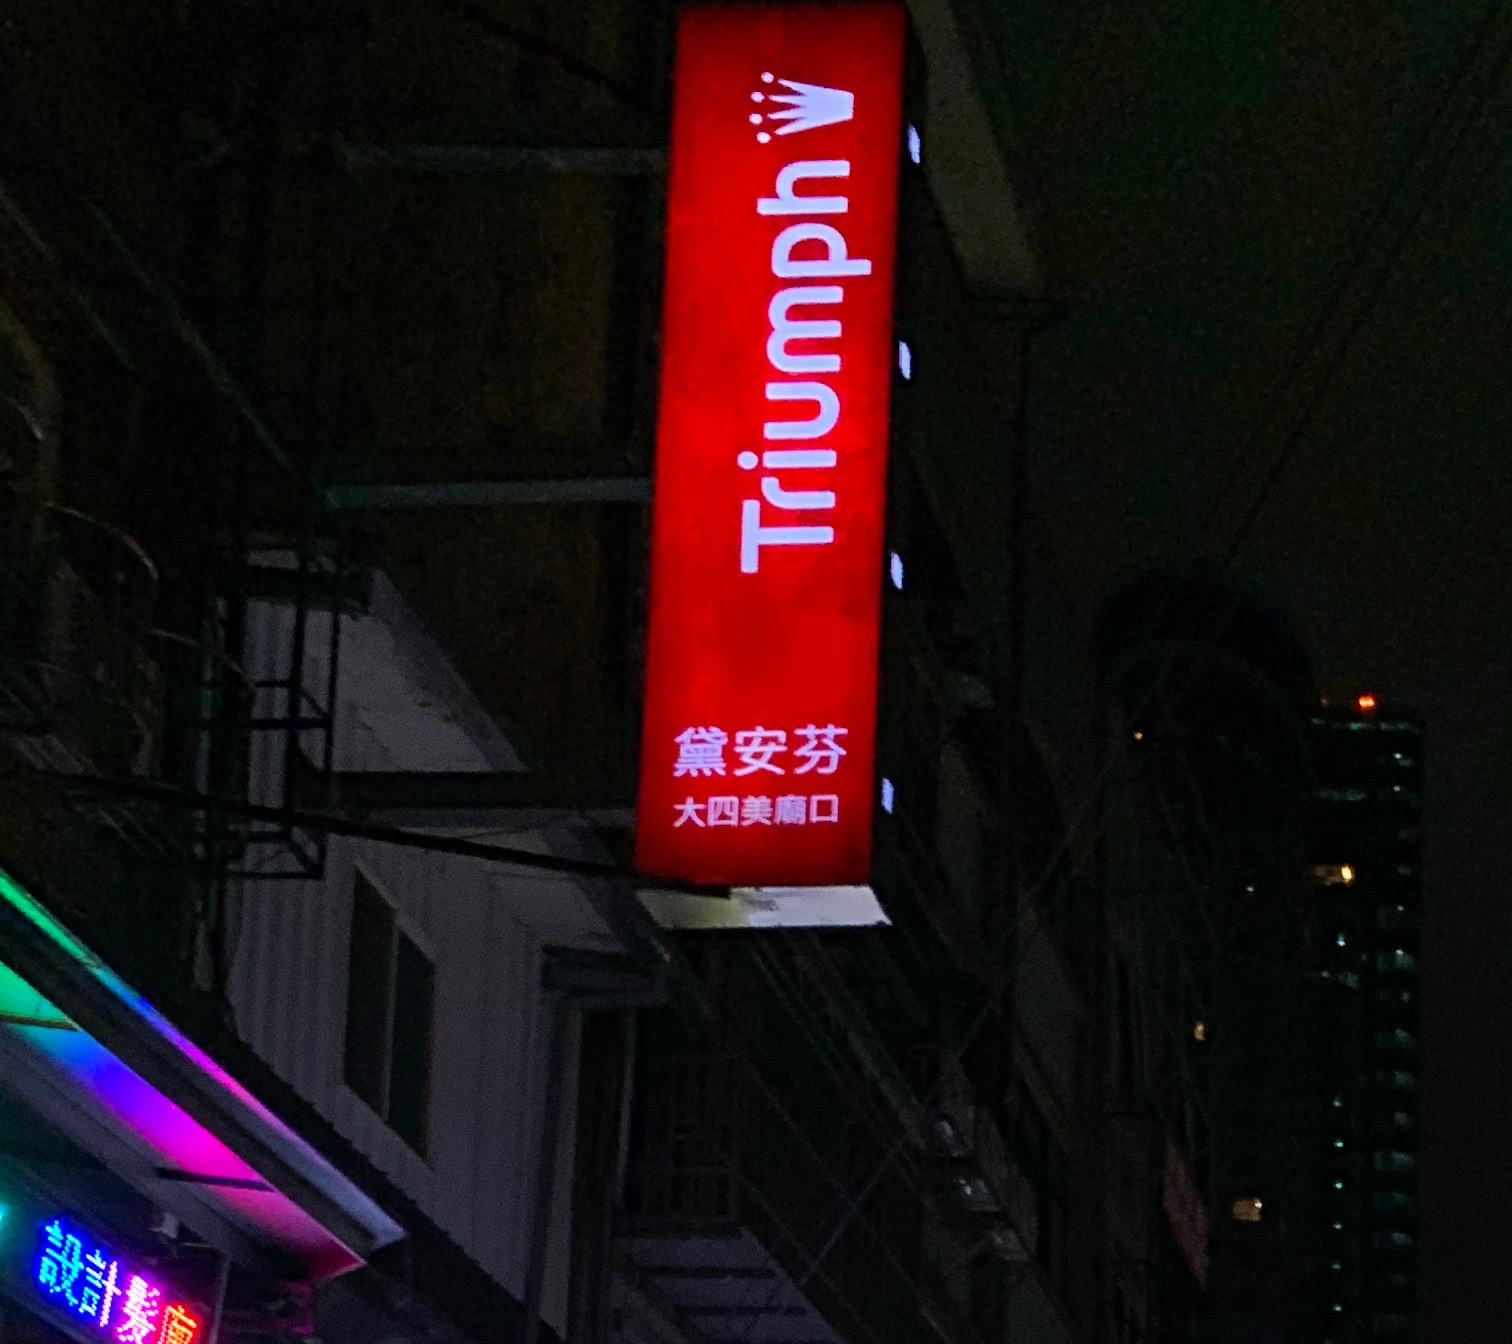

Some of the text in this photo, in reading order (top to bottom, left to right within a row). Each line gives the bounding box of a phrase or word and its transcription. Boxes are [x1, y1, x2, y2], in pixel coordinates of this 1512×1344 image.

[737, 160, 871, 573] Triumph
[673, 725, 848, 778] 黛安芬
[672, 796, 840, 828] 大四美廟口
